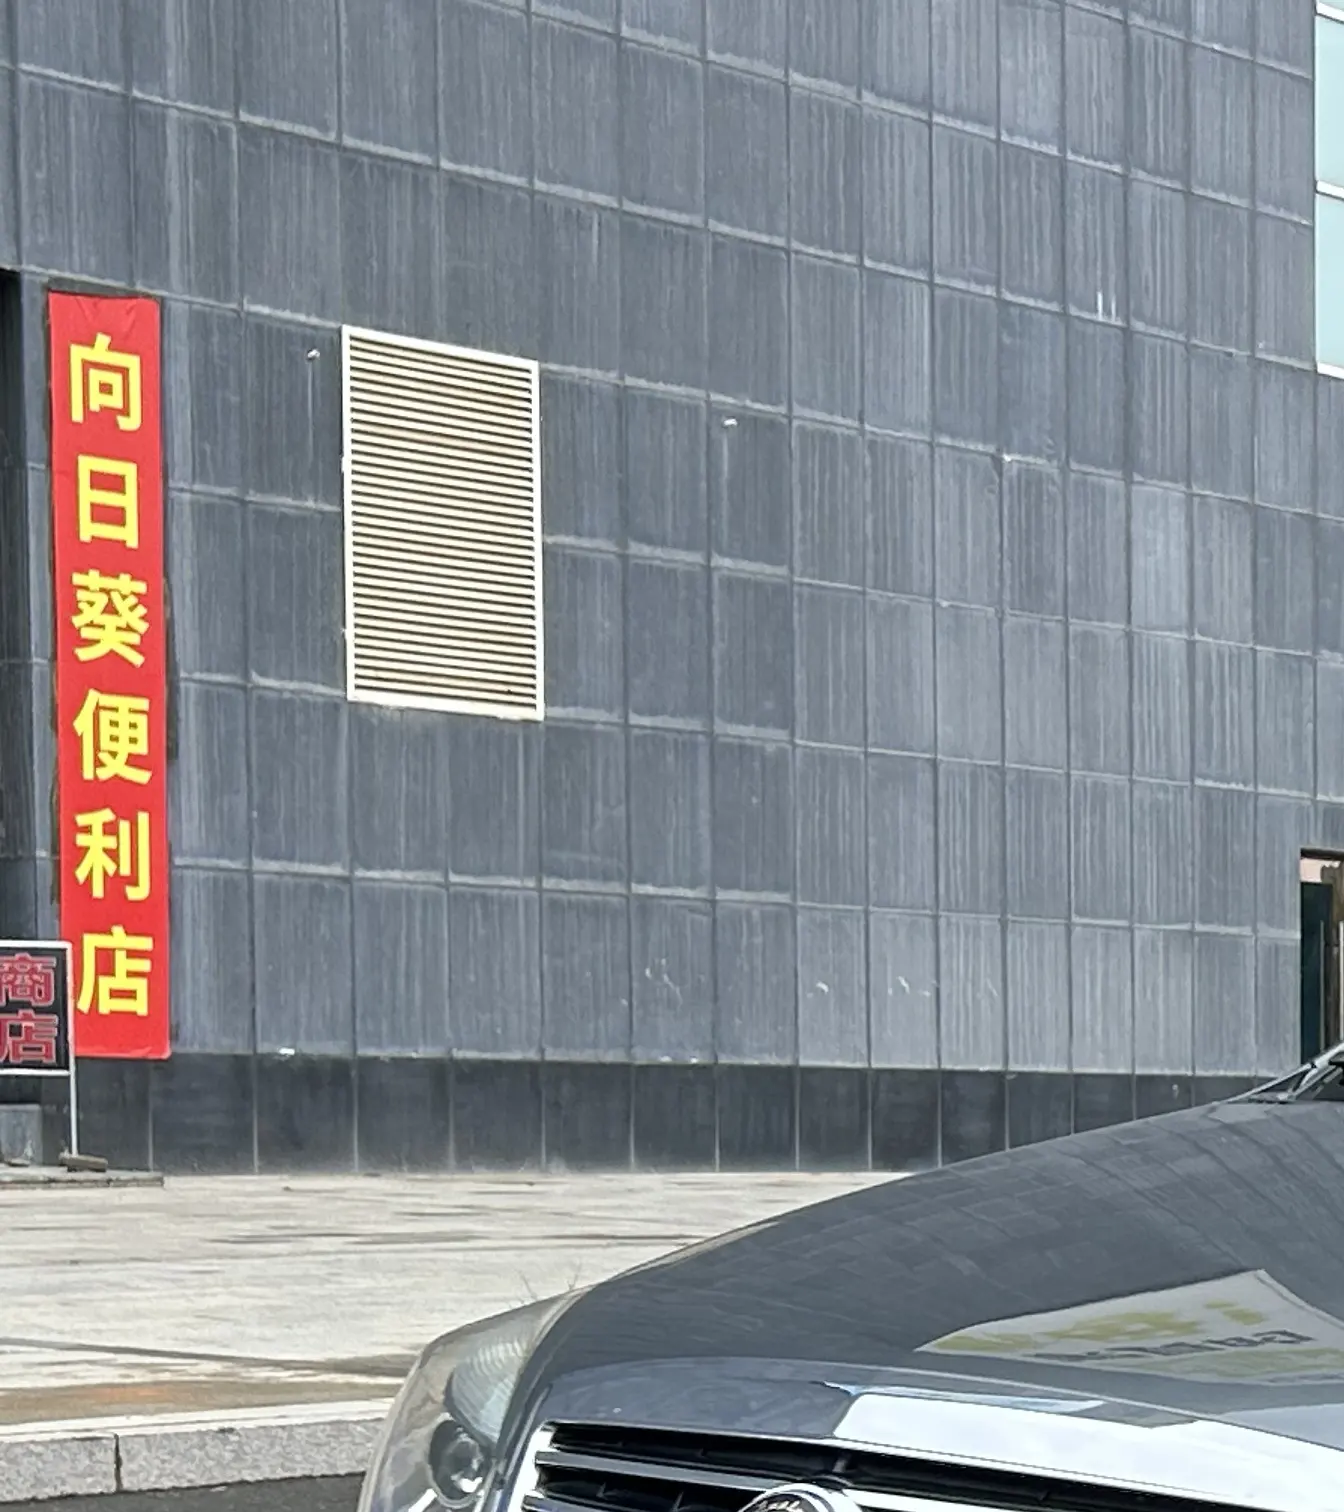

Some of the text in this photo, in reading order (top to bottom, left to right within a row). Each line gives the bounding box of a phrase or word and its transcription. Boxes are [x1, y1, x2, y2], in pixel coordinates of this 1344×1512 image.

[68, 333, 153, 1017] 向日葵便利店
